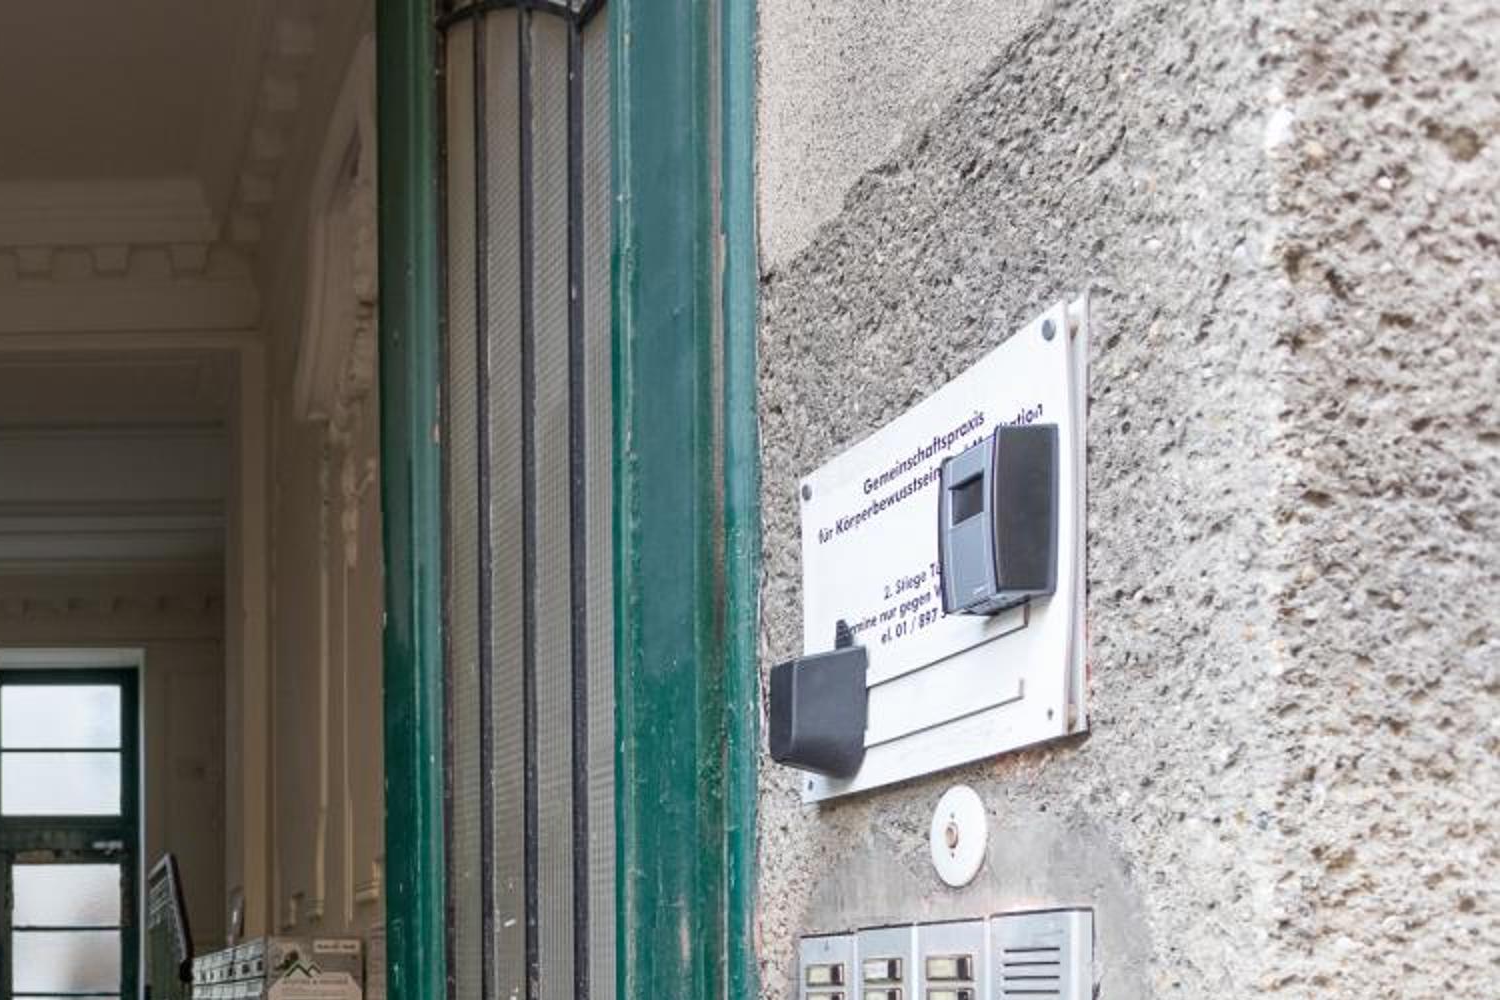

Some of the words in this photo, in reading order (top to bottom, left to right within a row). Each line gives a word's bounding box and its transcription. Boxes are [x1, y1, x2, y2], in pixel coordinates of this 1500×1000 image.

[863, 411, 985, 495] Gemeinschaftspraxis
[818, 526, 834, 545] für
[895, 571, 927, 594] Stiege
[879, 607, 897, 623] nur
[899, 591, 931, 619] gegen
[895, 620, 907, 637] 01
